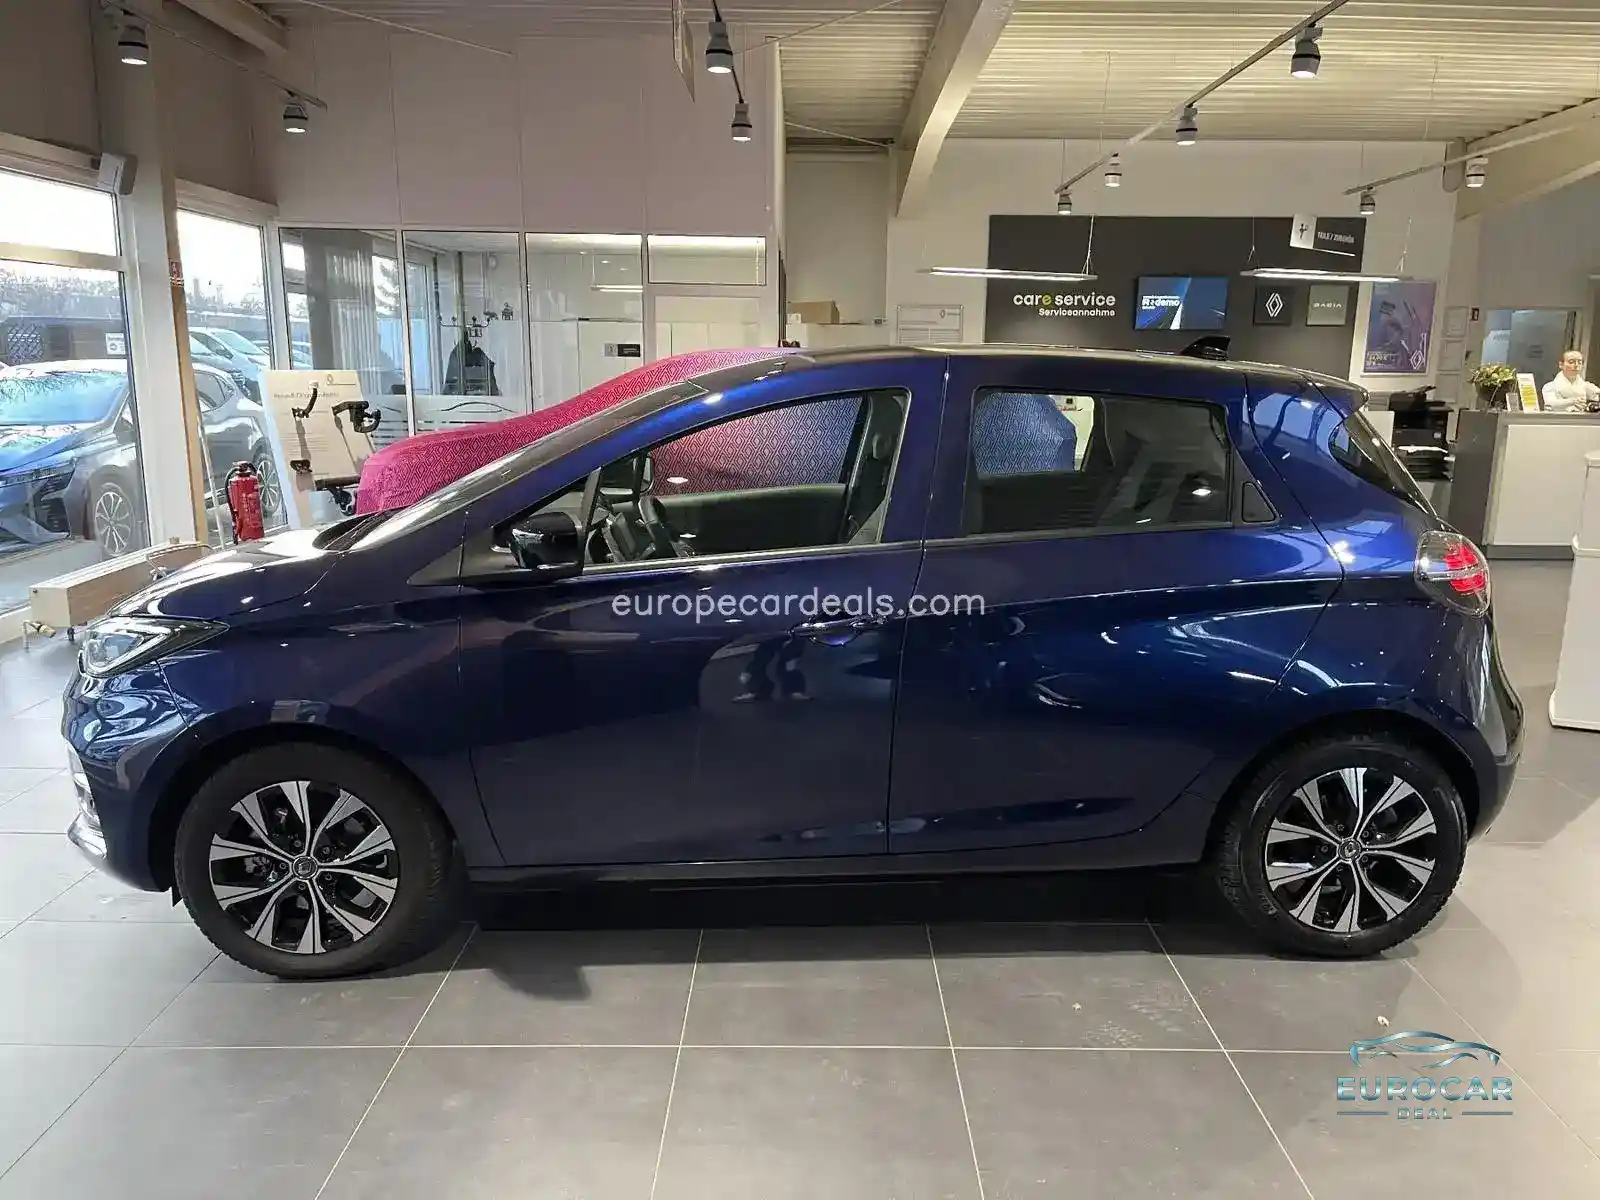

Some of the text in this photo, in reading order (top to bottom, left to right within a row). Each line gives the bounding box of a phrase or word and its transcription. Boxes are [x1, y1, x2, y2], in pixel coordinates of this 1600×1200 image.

[1013, 291, 1116, 306] care service
[1038, 307, 1115, 317] Serviceannahme
